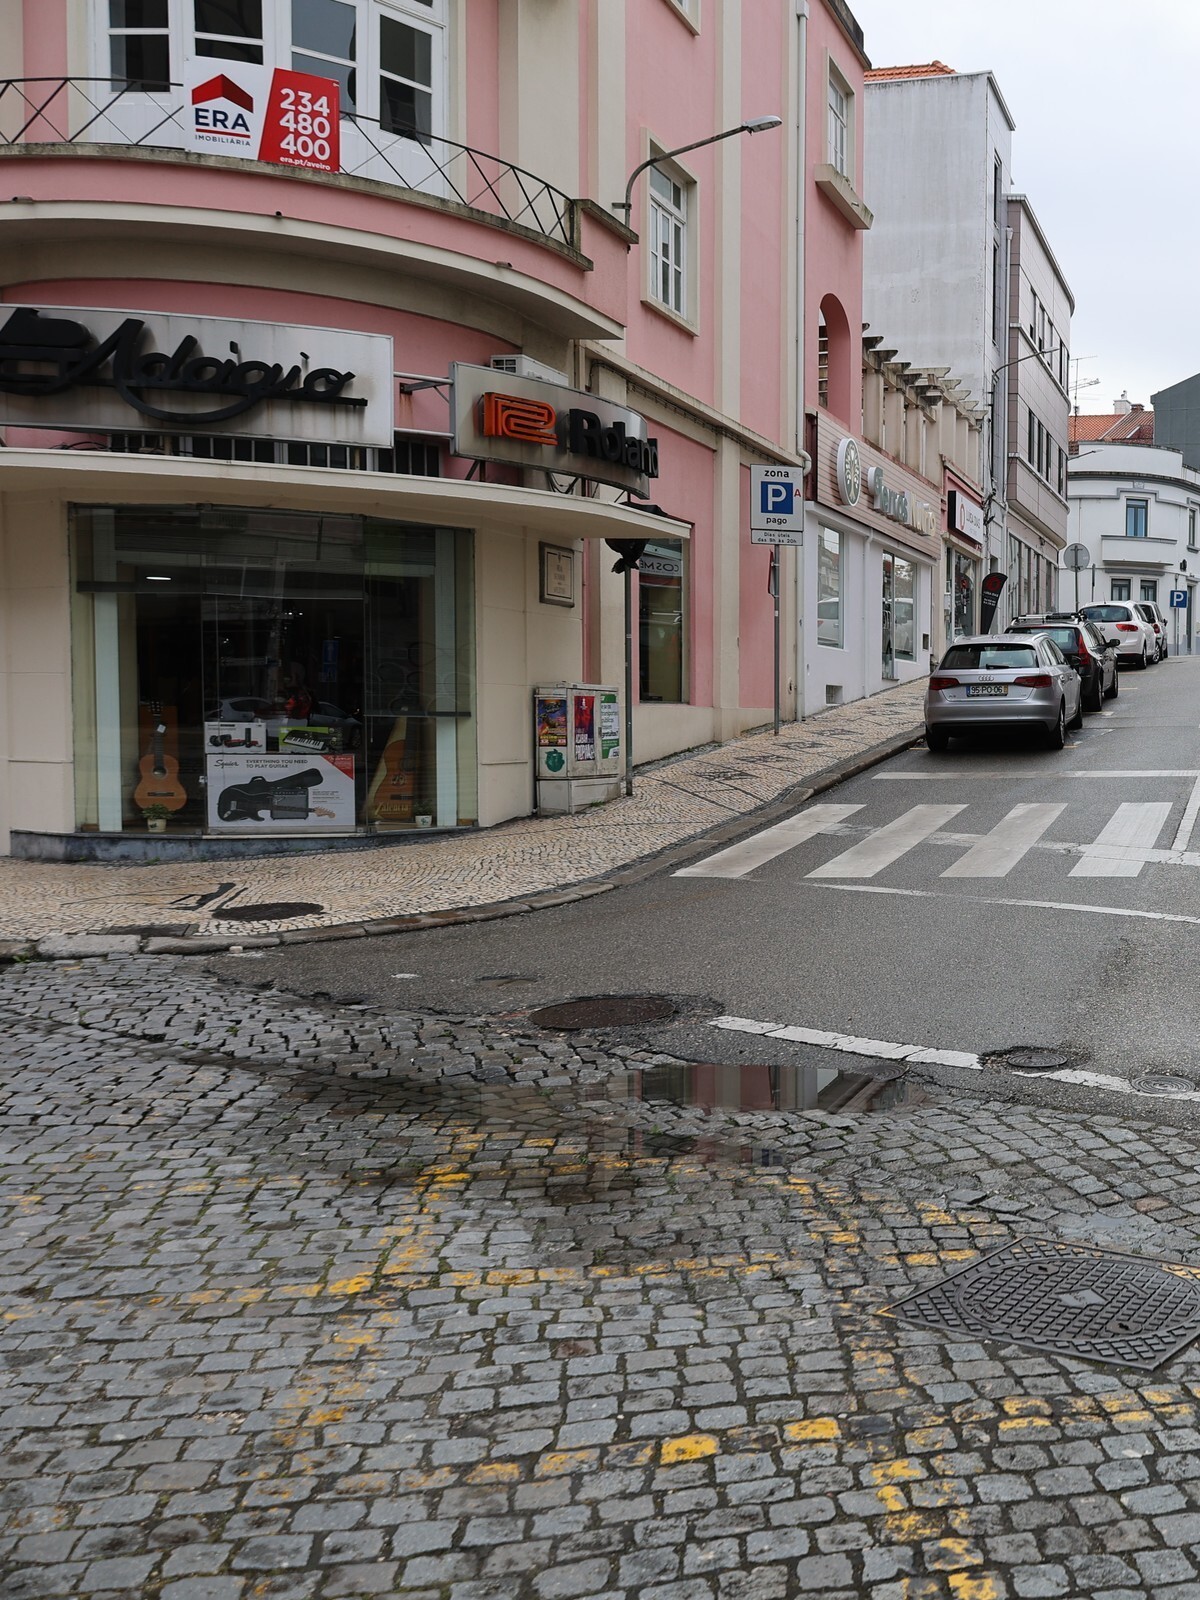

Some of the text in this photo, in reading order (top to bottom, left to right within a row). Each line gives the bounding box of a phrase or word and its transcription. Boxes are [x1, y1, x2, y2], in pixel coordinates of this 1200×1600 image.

[280, 87, 330, 117] 234
[195, 107, 250, 132] ERA
[279, 111, 331, 138] 480
[195, 134, 251, 147] IMOBILIÁRIA
[280, 133, 331, 160] 400
[280, 156, 331, 171] era.pt/aveiro
[569, 408, 659, 478] Roland
[764, 470, 789, 478] zona
[767, 484, 787, 511] P
[794, 489, 801, 497] A
[766, 517, 787, 525] pago
[1173, 591, 1184, 606] P
[213, 759, 240, 769] Squier
